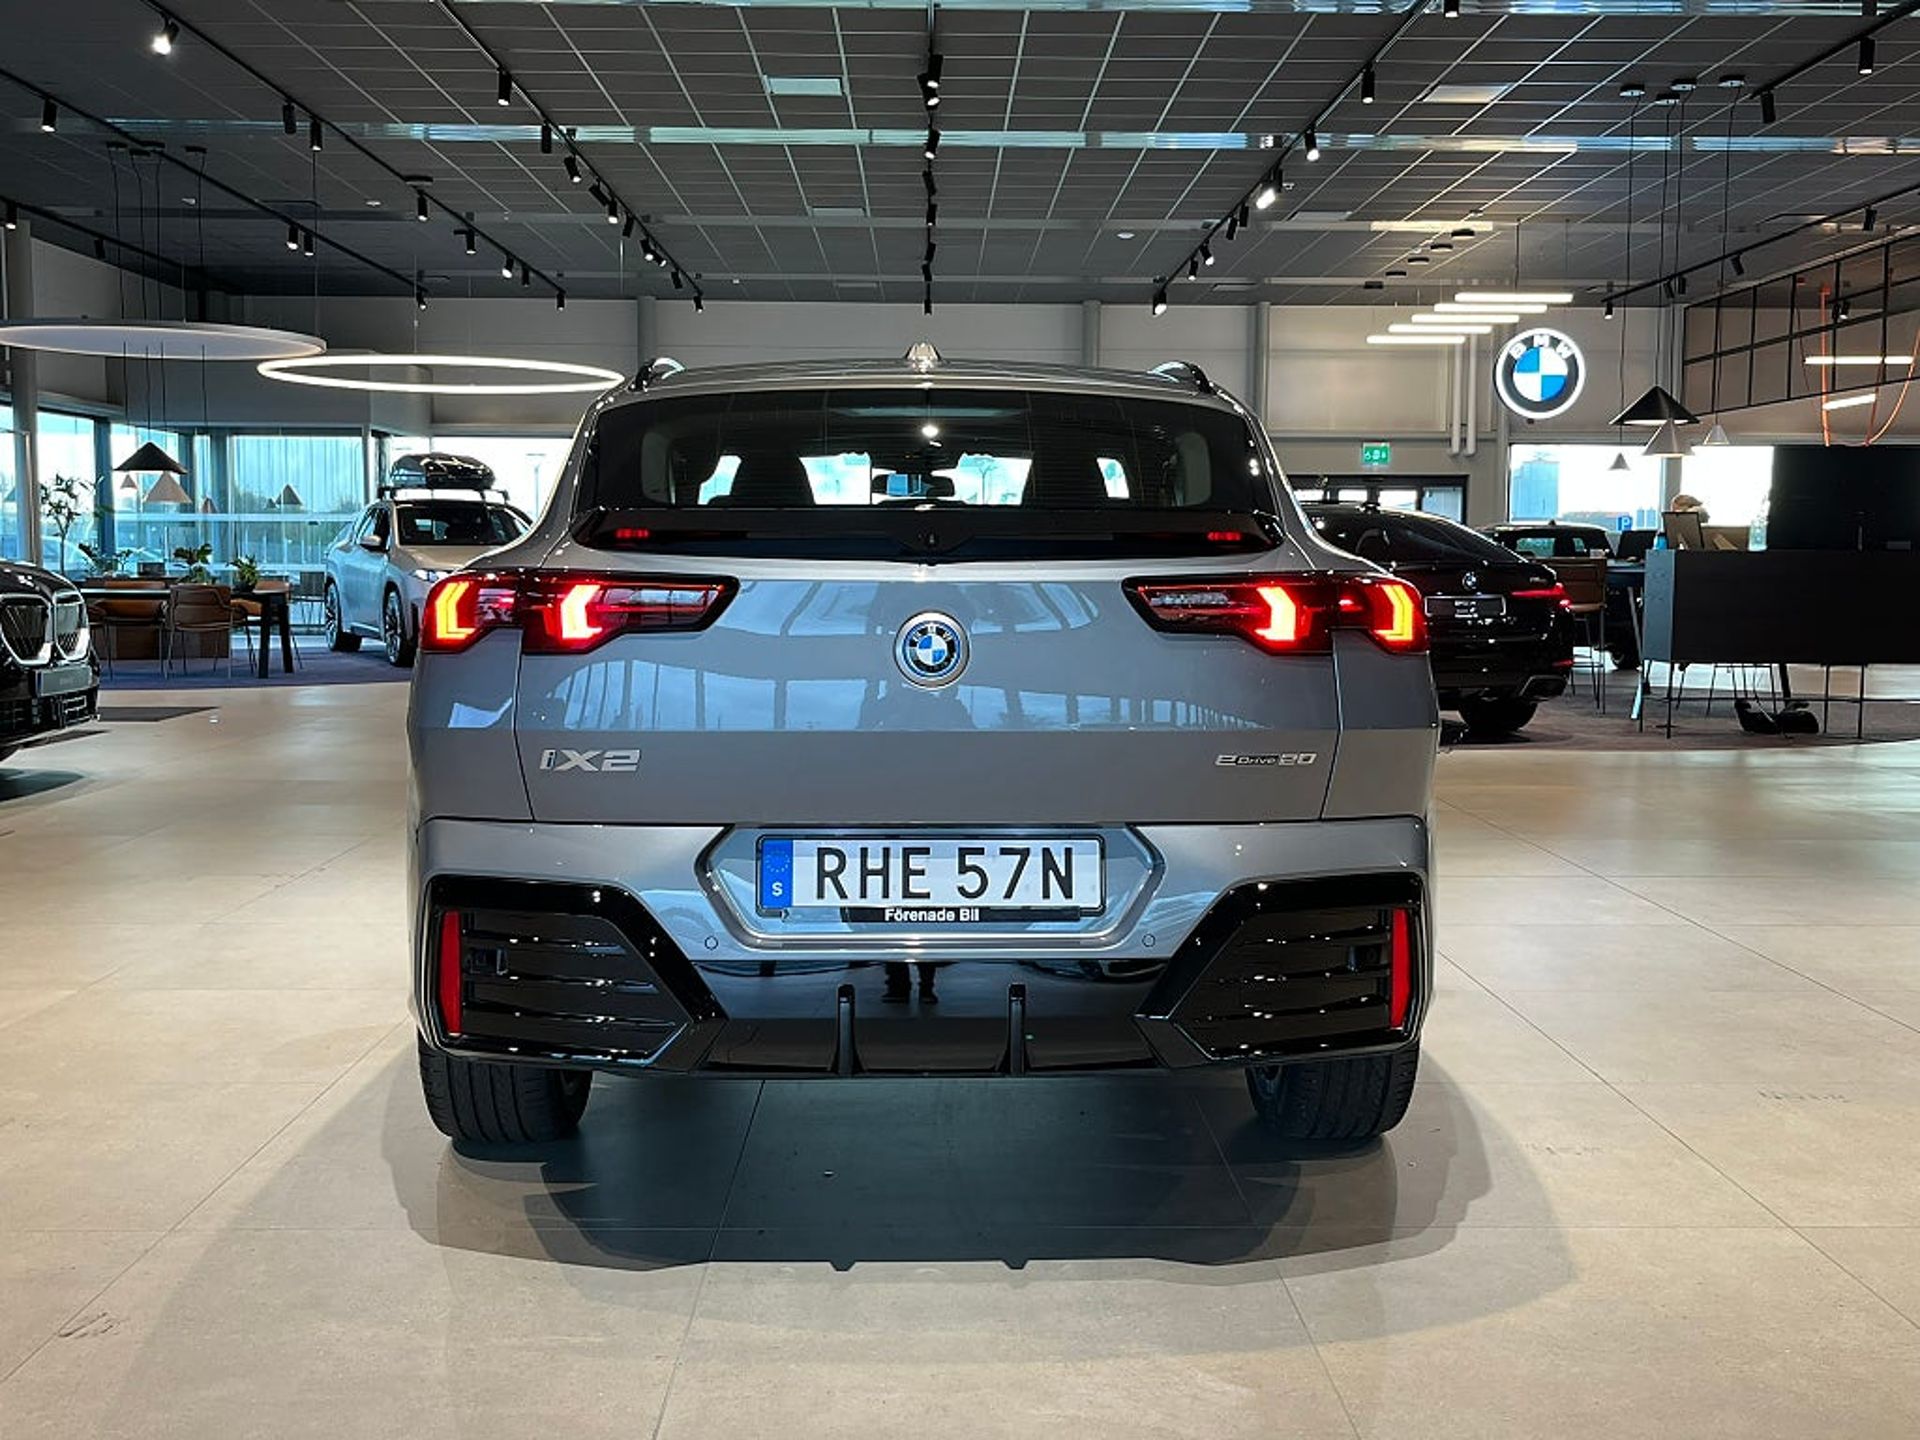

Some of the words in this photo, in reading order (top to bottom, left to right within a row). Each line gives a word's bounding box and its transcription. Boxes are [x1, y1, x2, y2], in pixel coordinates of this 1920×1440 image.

[540, 749, 640, 772] iX2
[816, 847, 931, 899] RHE
[956, 847, 1073, 899] 57N
[772, 881, 783, 897] S
[884, 907, 955, 921] Förenade
